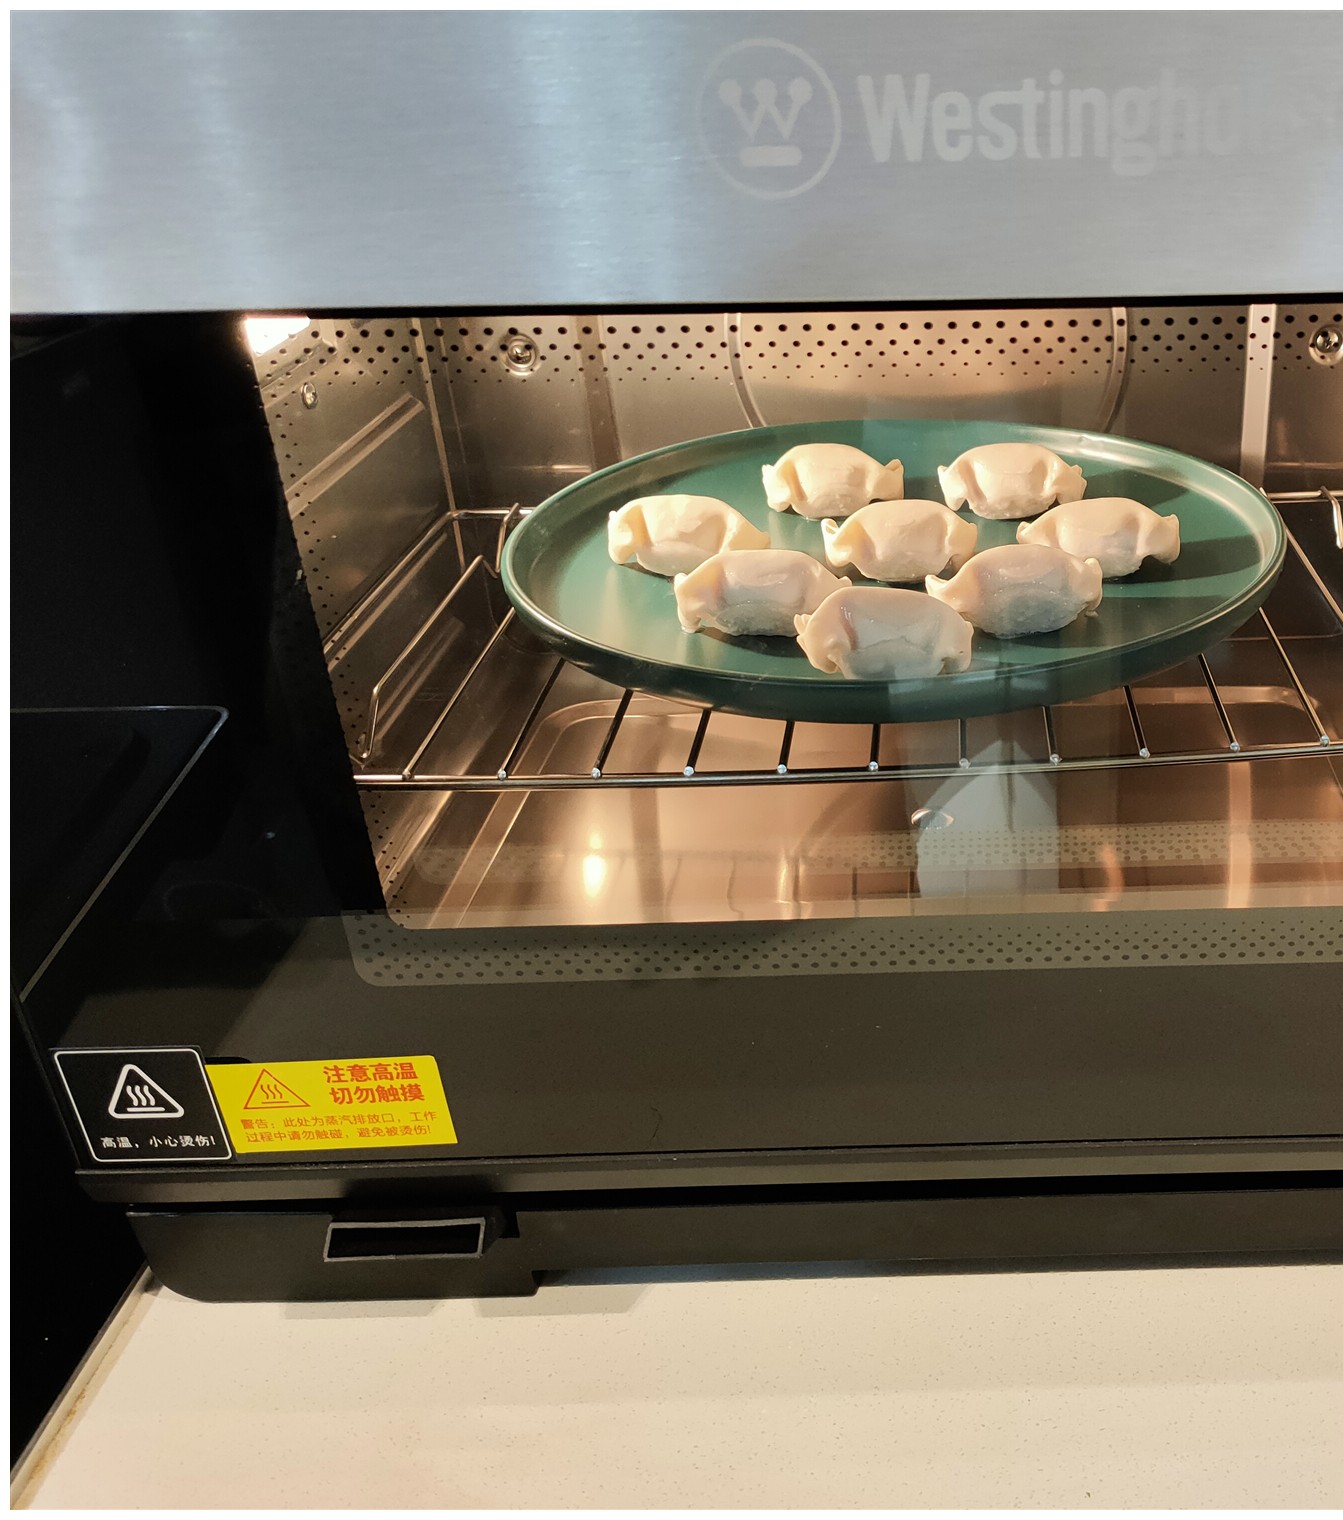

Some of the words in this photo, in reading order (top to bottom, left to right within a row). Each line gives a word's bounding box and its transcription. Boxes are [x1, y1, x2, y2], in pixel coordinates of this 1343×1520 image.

[322, 1062, 419, 1084] 注意高温
[329, 1083, 425, 1106] 切勿触摸
